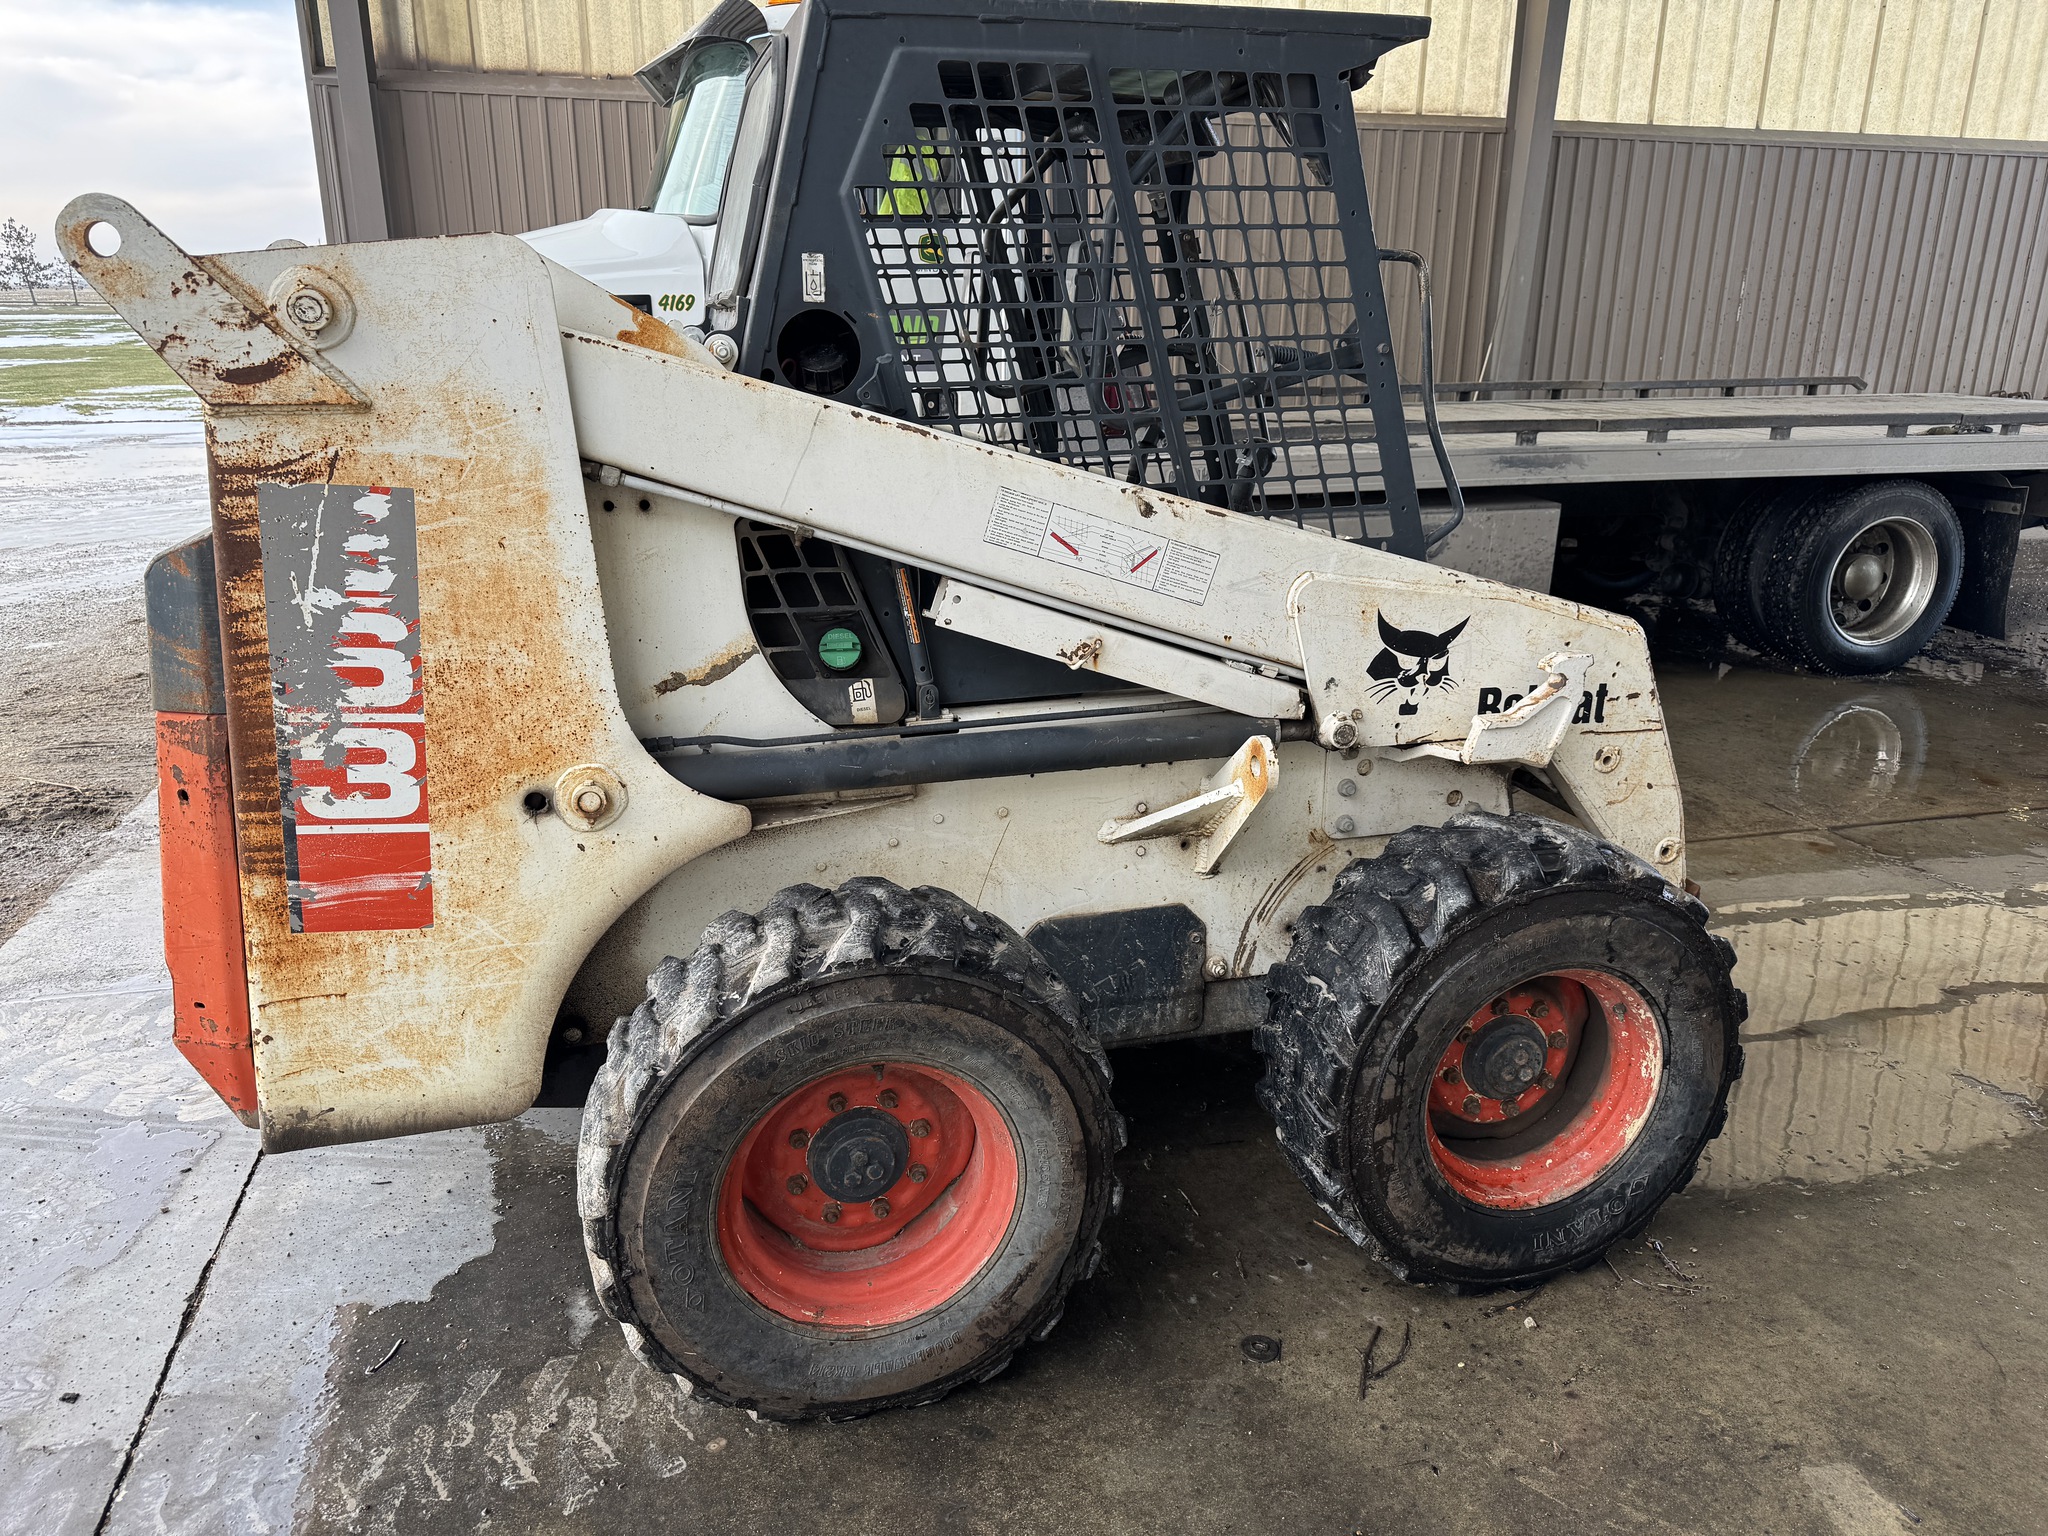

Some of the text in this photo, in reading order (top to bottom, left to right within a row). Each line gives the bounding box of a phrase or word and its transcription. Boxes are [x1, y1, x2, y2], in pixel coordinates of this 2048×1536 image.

[658, 293, 696, 312] 4169
[827, 632, 854, 640] DIESEL
[1477, 682, 1608, 725] Boat
[663, 1169, 698, 1287] OTANI
[1532, 1194, 1629, 1252] OTANI
